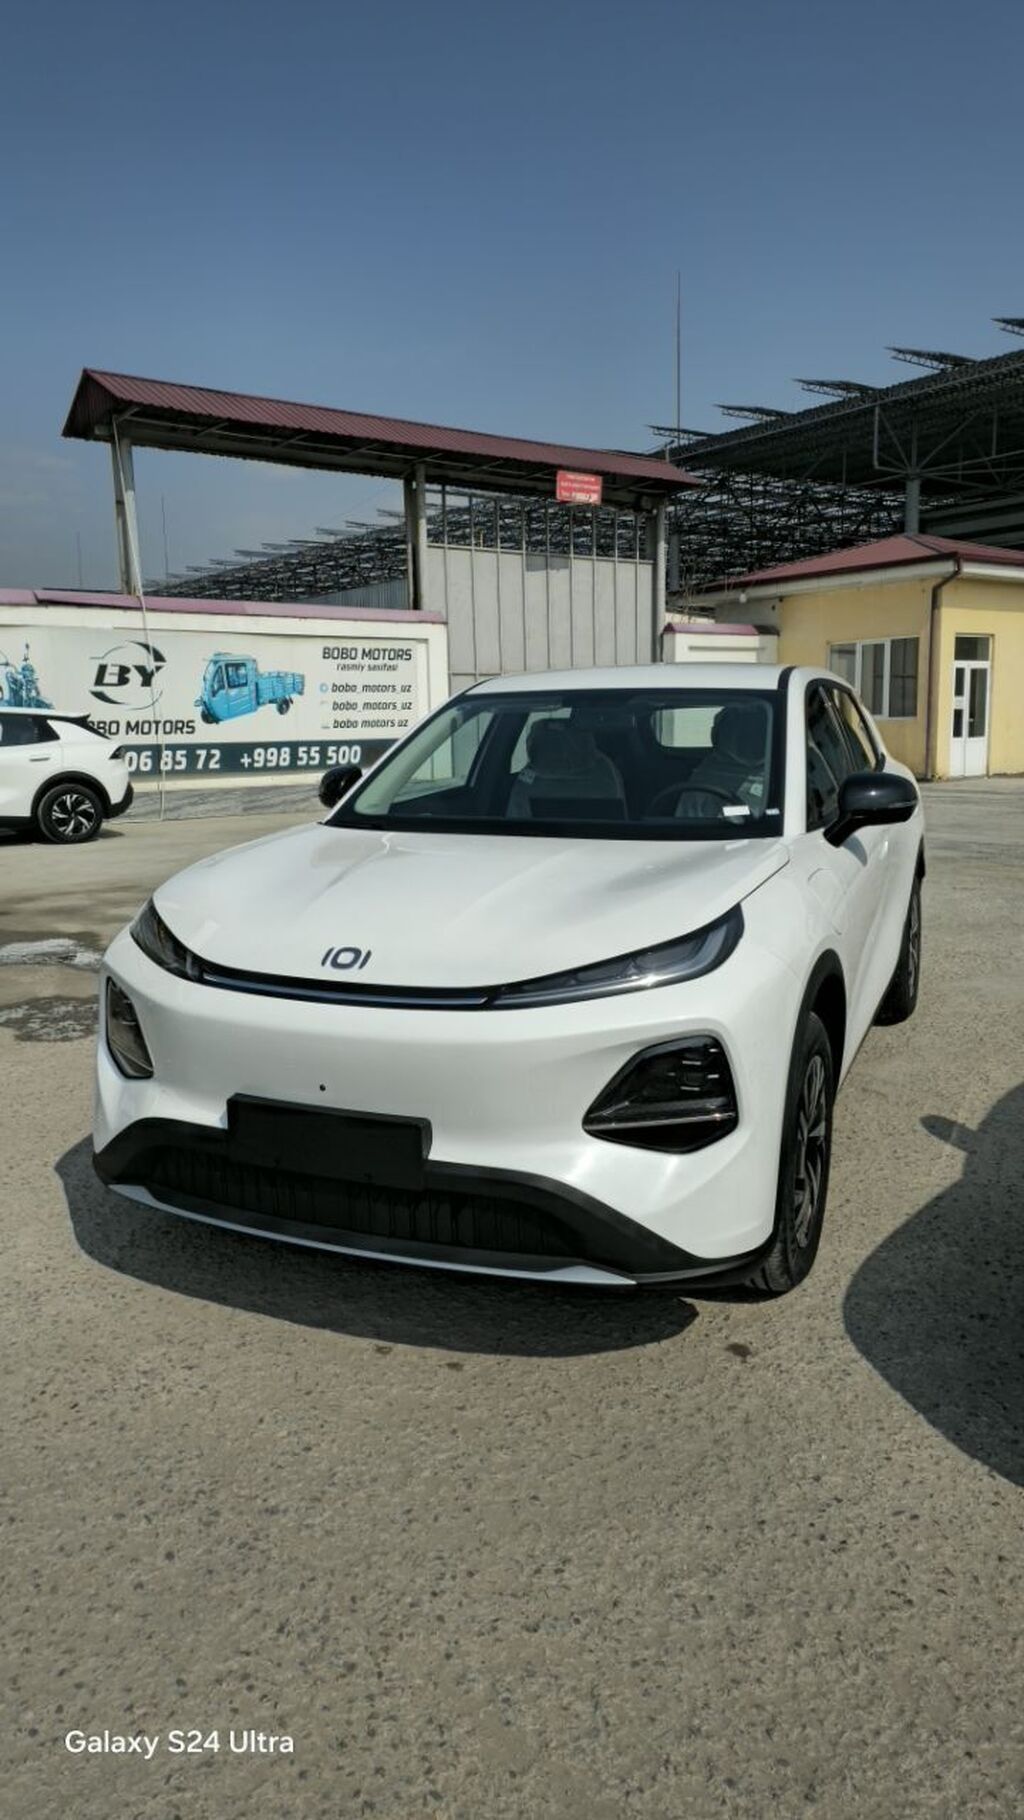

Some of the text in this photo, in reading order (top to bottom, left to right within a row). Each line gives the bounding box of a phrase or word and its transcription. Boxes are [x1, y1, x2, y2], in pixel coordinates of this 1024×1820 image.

[322, 647, 412, 661] BOBO MOTORS
[94, 664, 164, 687] BY
[125, 720, 196, 736] MOTORS
[125, 745, 361, 772] 06 85 72 +998 55 500
